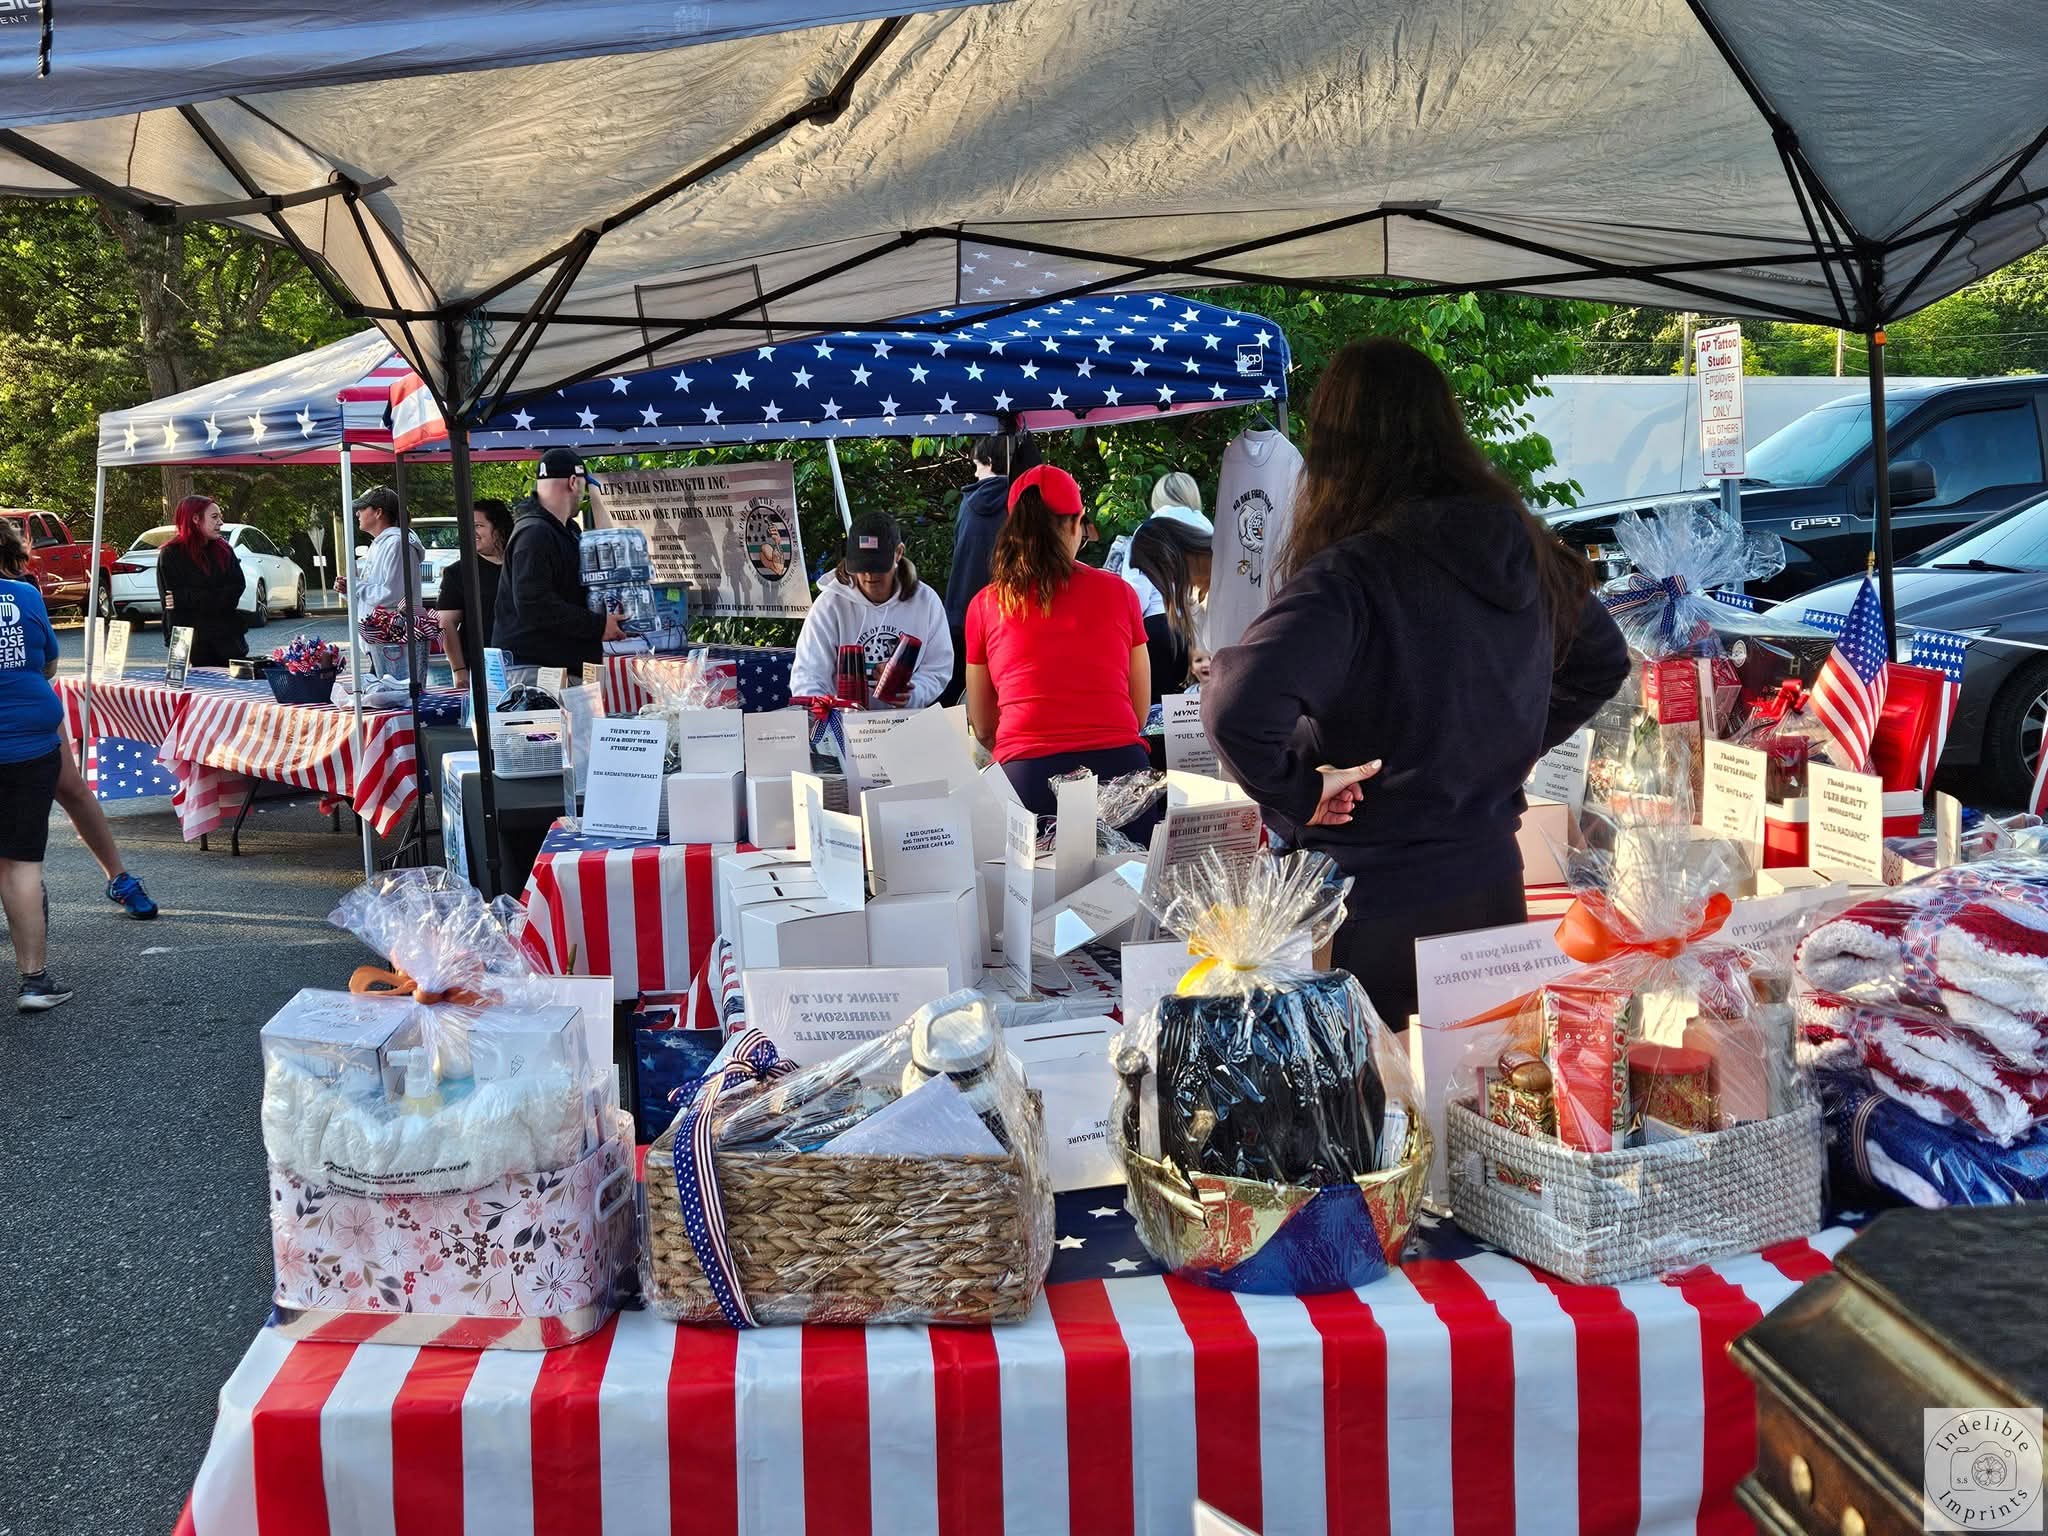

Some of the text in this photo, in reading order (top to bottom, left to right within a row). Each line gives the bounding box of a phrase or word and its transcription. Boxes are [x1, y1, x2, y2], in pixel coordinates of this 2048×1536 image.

[1701, 338, 1737, 352] AP Tattoo
[1708, 354, 1732, 367] Studio
[1705, 372, 1736, 386] Employee
[1709, 390, 1733, 402] Parking
[1713, 404, 1732, 418] ONLY
[1706, 423, 1739, 435] ALL OTHERS
[626, 479, 650, 495] TALK
[653, 476, 706, 493] STRENGTH
[707, 475, 730, 490] INC.
[759, 496, 775, 508] THE
[610, 504, 735, 521] WHERE NO ONE FIGHTS ALONE
[1, 626, 24, 636] HAS
[881, 625, 897, 634] THE
[4, 660, 27, 669] RENT
[1173, 709, 1198, 717] MVNC
[1720, 752, 1735, 762] Thank
[1735, 757, 1745, 765] you
[1827, 777, 1844, 788] Thank
[1845, 783, 1856, 791] you
[1823, 790, 1868, 809] ULTA BEAUTY
[920, 828, 944, 836] OUTBACK
[1067, 1131, 1104, 1145] TREASURE
